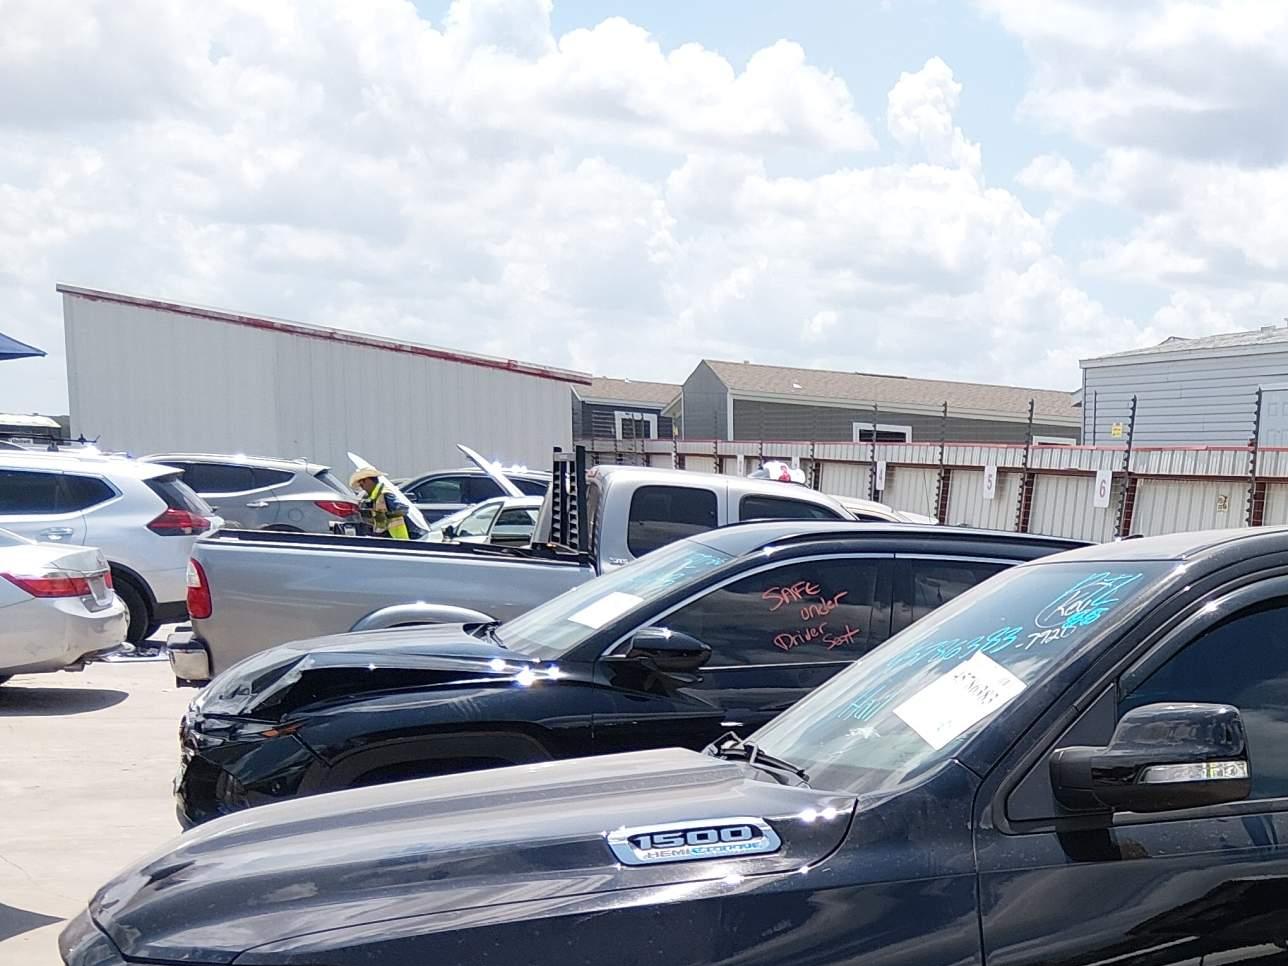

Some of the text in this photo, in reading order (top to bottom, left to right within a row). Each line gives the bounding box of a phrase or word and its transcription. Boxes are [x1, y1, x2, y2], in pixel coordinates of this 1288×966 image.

[986, 473, 993, 490] 5
[1098, 479, 1106, 498] 6
[762, 580, 821, 611] SAFE
[800, 591, 848, 621] under
[774, 622, 828, 651] Driver
[633, 825, 753, 850] 1500
[645, 847, 690, 859] HEMI
